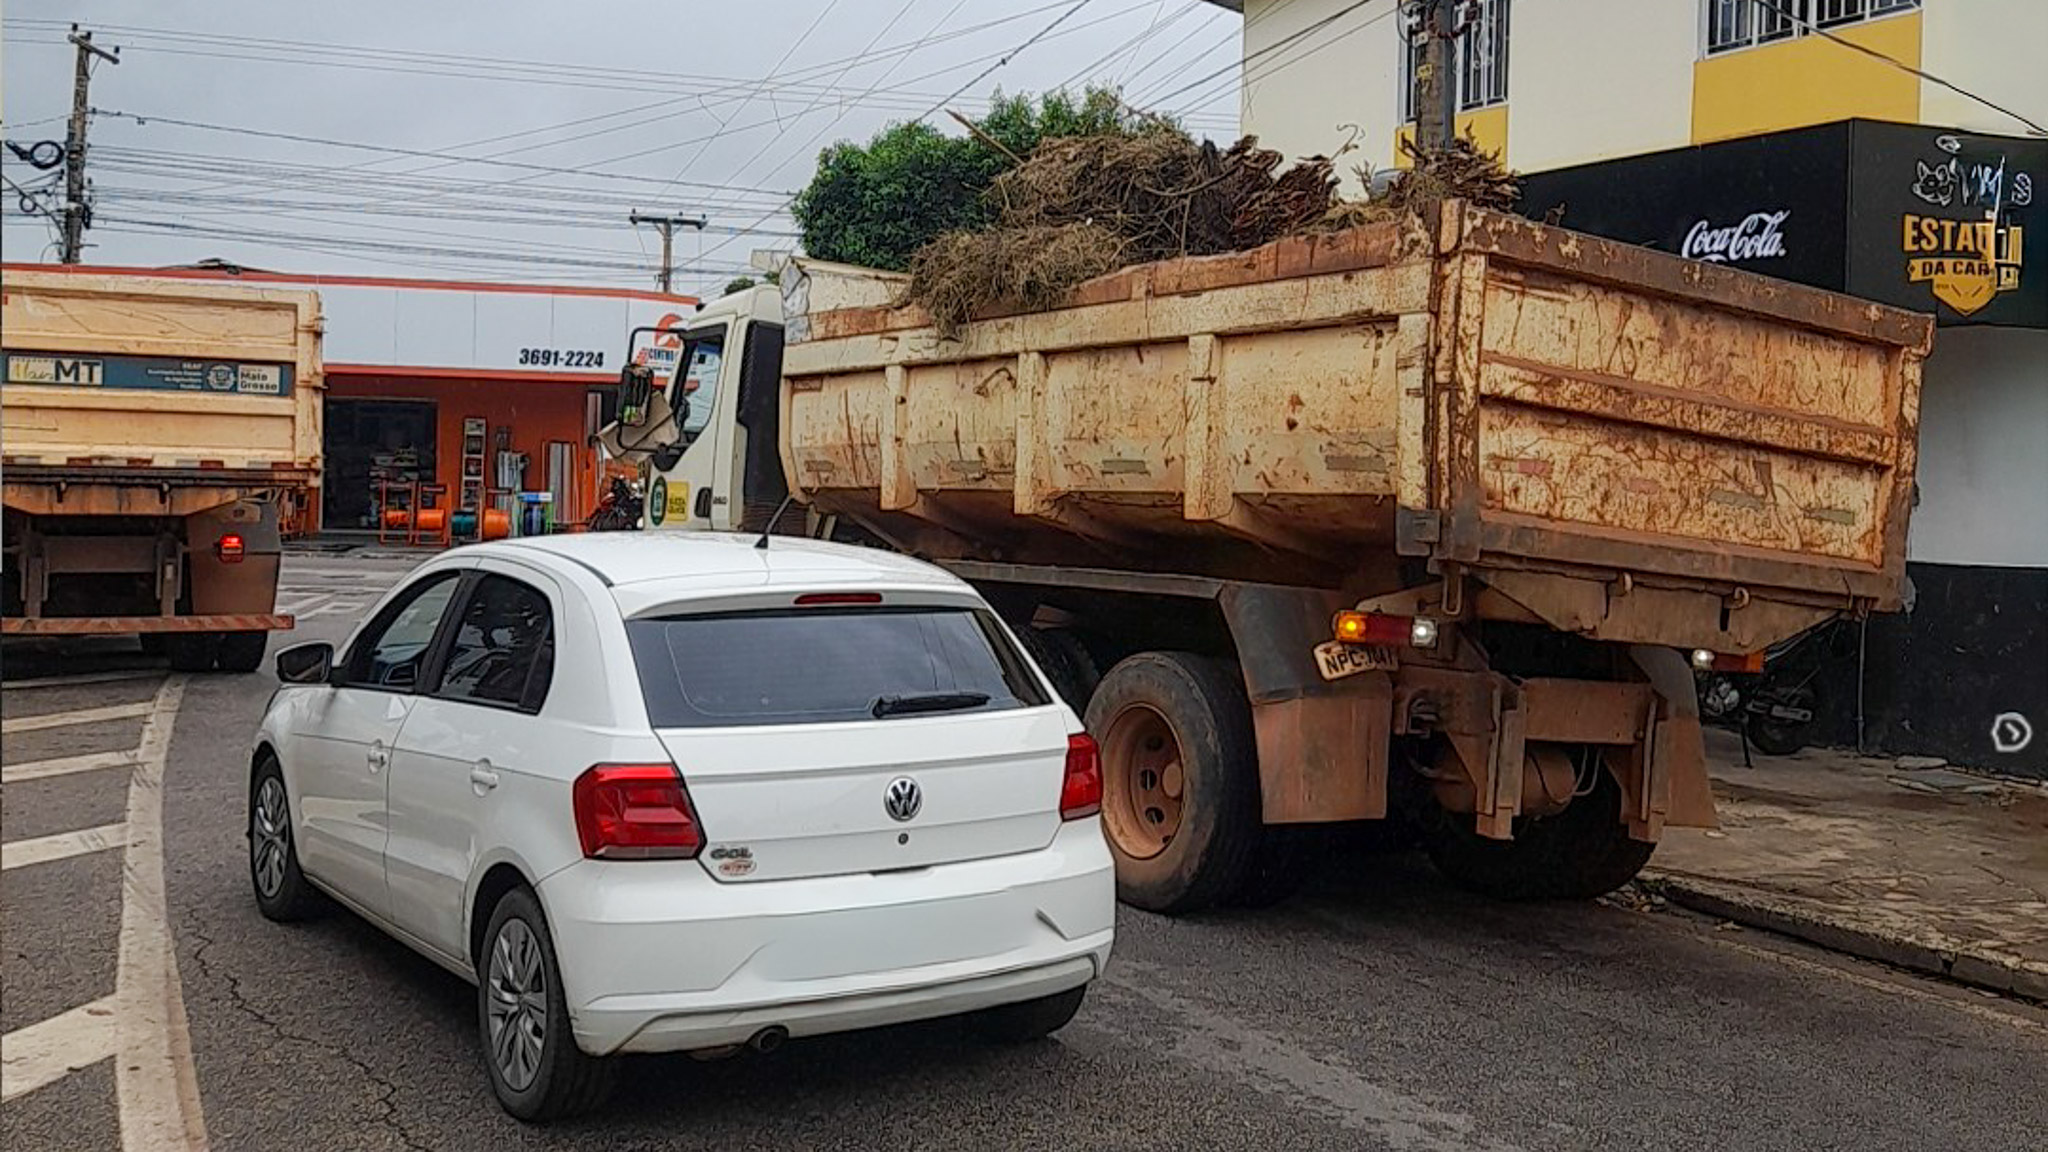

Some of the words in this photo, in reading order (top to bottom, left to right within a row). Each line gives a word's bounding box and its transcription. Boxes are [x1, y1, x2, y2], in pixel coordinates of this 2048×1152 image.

[1682, 209, 1791, 261] Coca-Cola
[1922, 261, 1945, 277] DA
[519, 348, 604, 368] 3691-2224
[55, 360, 101, 383] MT
[240, 380, 278, 391] Grosso
